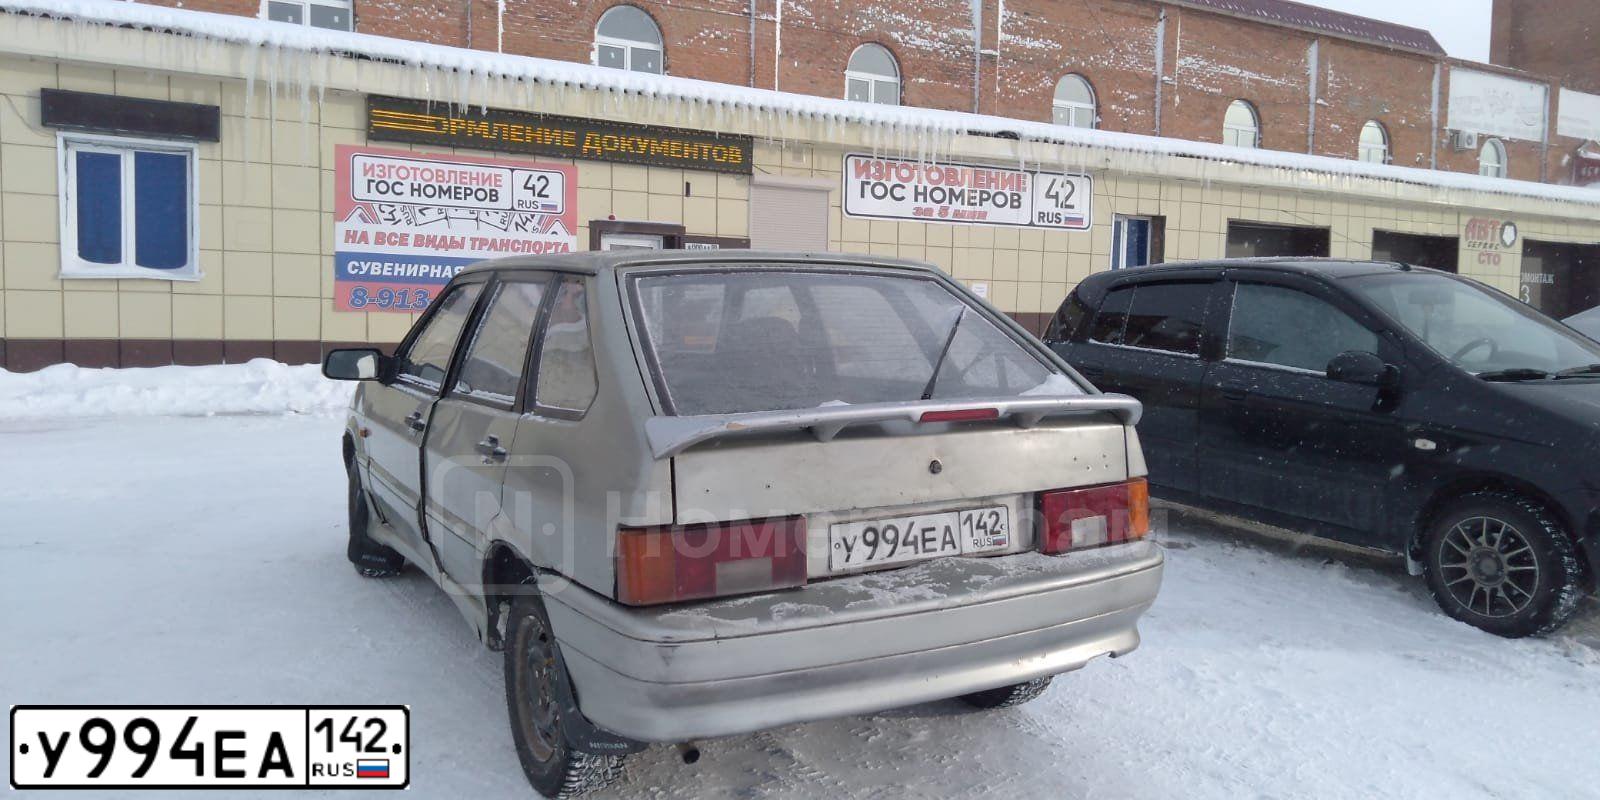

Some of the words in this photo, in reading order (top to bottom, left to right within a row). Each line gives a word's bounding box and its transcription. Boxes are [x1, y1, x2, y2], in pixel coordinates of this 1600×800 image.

[582, 132, 743, 164] ДОКУМЕНТОВ
[363, 162, 503, 188] ИЗГОТОВЛЕНИЕ
[523, 174, 550, 199] 42
[854, 159, 1026, 192] ИЗГОТОВЛЕНИЕ
[367, 179, 404, 196] ГОС
[410, 184, 500, 203] НОМЕРОВ
[860, 180, 906, 202] ГОС
[914, 185, 1022, 209] НОМЕРОВ
[1045, 178, 1075, 210] 42
[517, 200, 539, 210] RUS
[912, 206, 934, 218] за
[938, 206, 949, 218] 5
[952, 209, 988, 220] мин
[1038, 212, 1062, 224] RUS
[344, 230, 369, 245] НА
[374, 232, 409, 247] ВСЕ
[413, 235, 465, 251] ВИДЫ
[469, 237, 570, 254] ТРАНСПОРТА
[1478, 251, 1501, 266] СТО
[963, 510, 1000, 538] 142
[842, 520, 957, 562] У994ЕА
[972, 537, 992, 548] RUS
